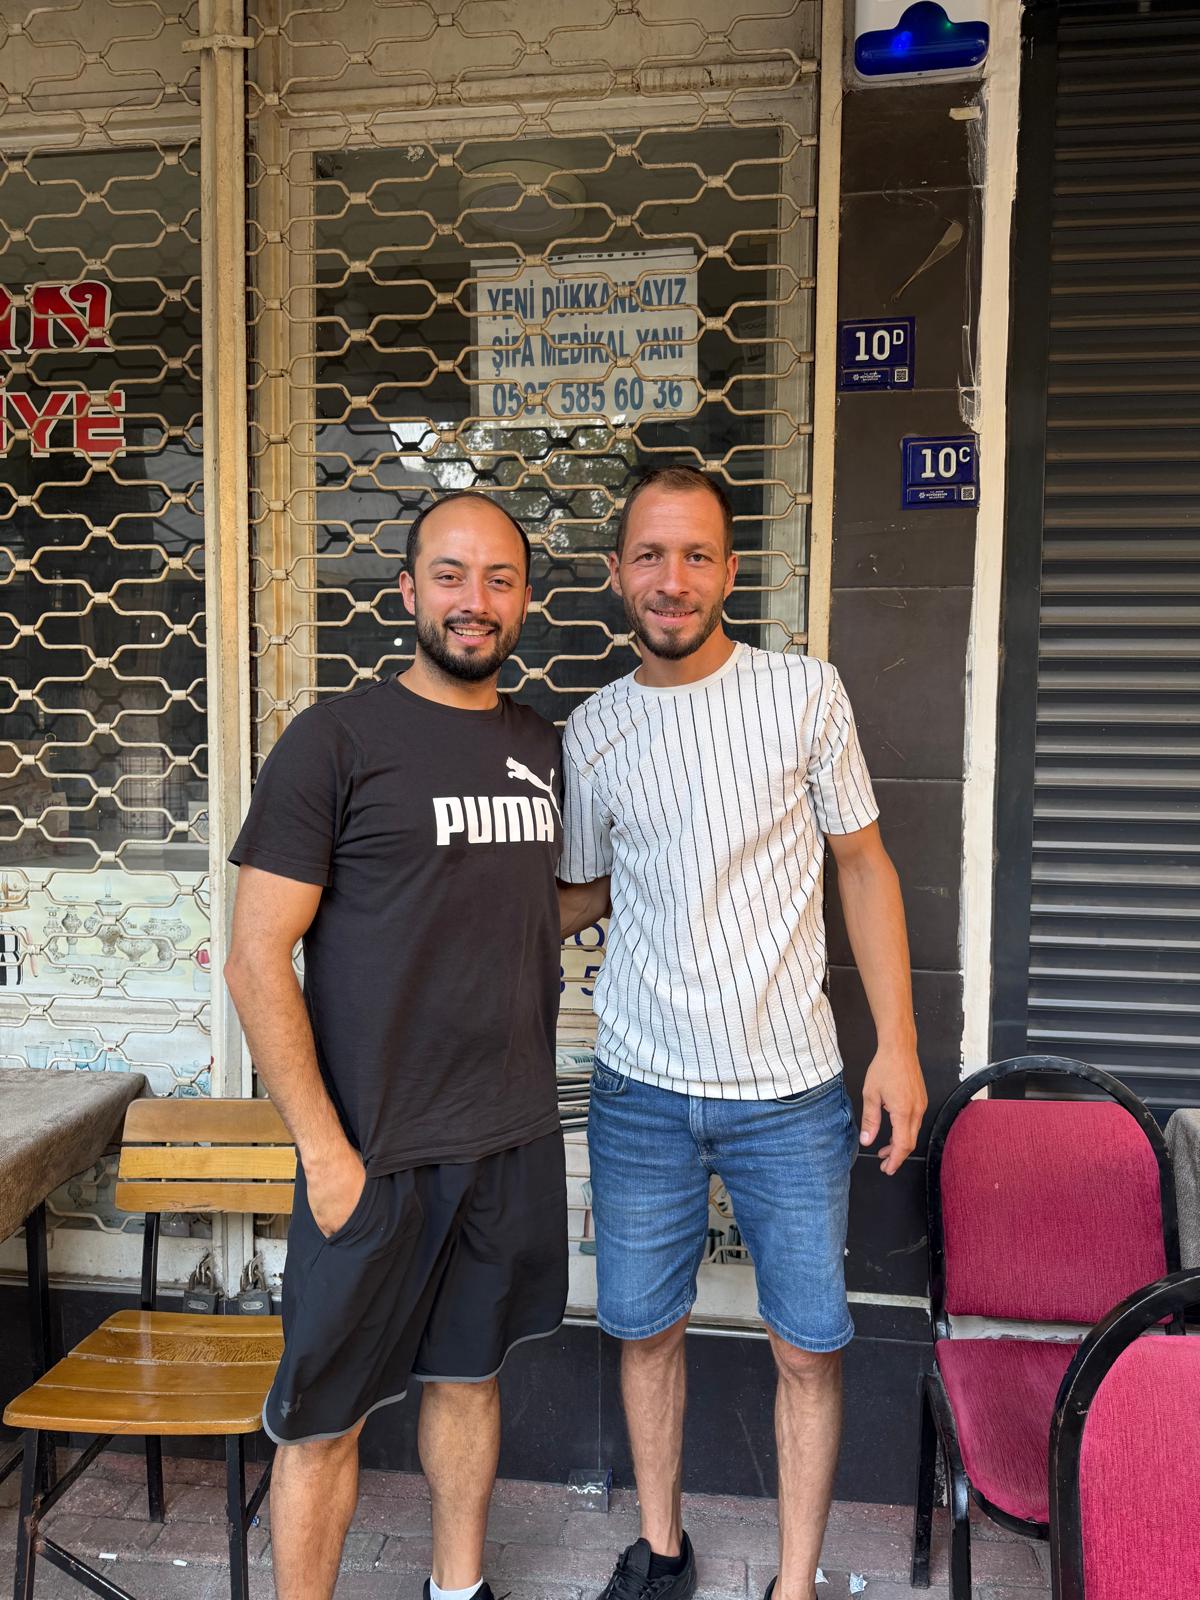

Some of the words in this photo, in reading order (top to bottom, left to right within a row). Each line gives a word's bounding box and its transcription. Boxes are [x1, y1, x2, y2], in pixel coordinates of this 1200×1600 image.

[487, 279, 535, 321] YENİ
[542, 277, 687, 320] DÜKKANDAYIZ
[492, 327, 535, 377] ŞİFA
[541, 323, 631, 368] MEDİKAL
[636, 326, 683, 360] YANI
[855, 329, 904, 362] 10D
[561, 380, 606, 414] 585
[614, 377, 644, 411] 60
[653, 376, 683, 409] 36
[921, 446, 971, 479] 10C
[432, 796, 554, 846] PUMA
